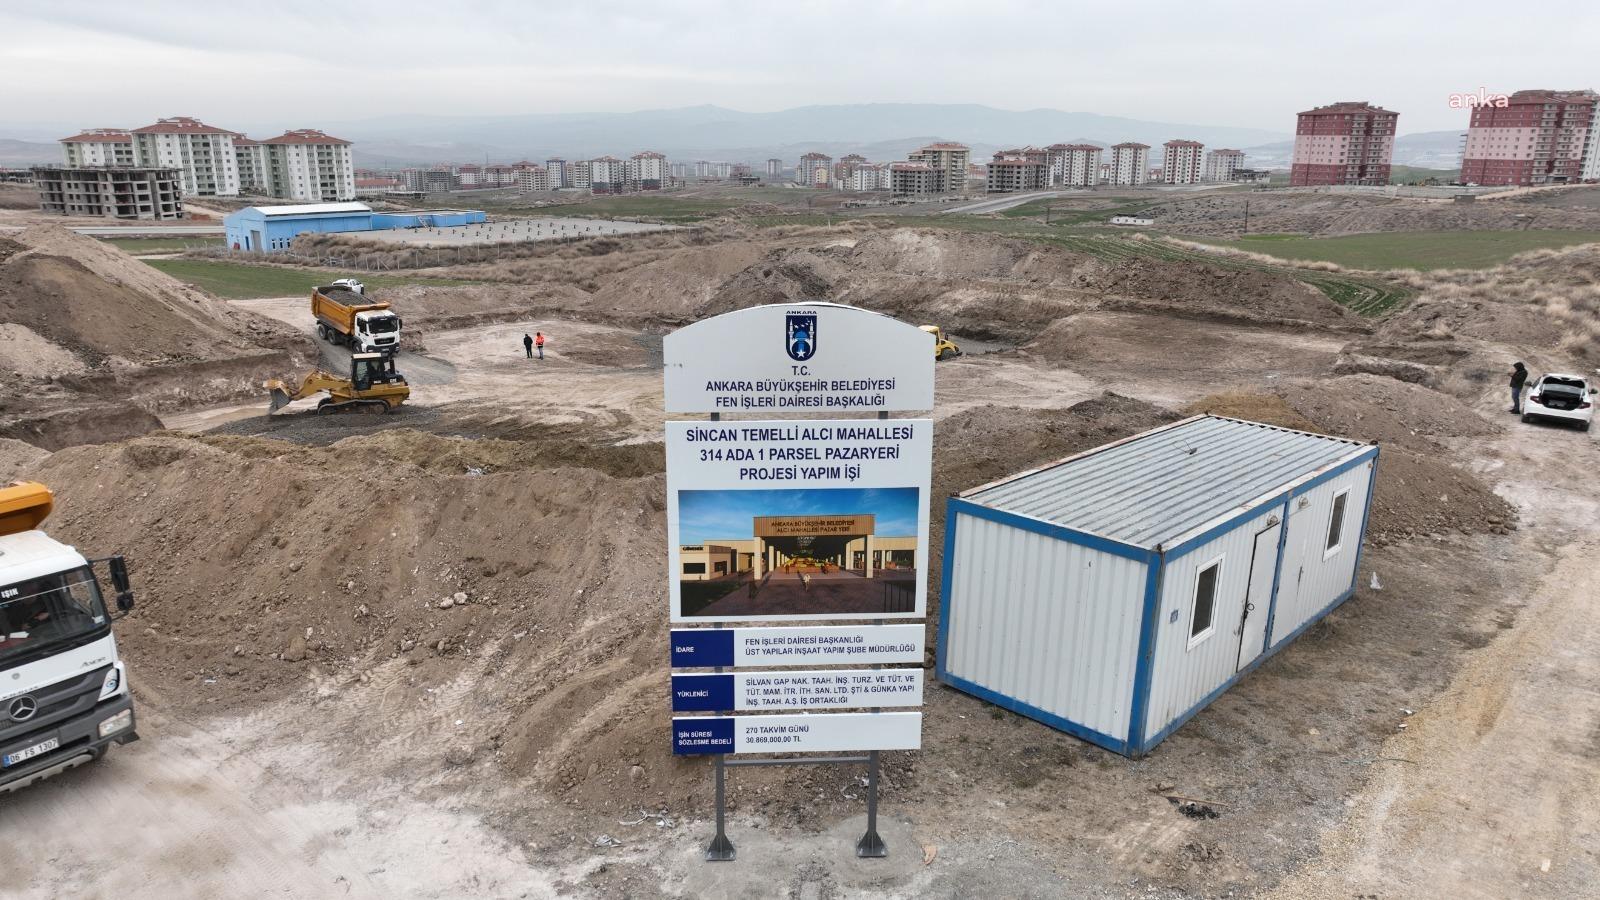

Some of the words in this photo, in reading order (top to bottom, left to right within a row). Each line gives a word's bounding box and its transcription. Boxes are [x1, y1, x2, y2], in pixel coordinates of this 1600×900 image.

[792, 366, 811, 376] T.C.
[706, 381, 753, 392] ANKARA
[756, 378, 829, 394] BÜYÜKŞEHİR
[831, 377, 896, 391] BELEDİYESİ
[716, 396, 738, 408] FEN
[741, 394, 776, 410] İŞLERİ
[779, 393, 823, 408] DAİRESİ
[826, 392, 885, 409] BAŞKALIĞI
[686, 426, 738, 442] SİNCAN
[741, 425, 799, 442] TEMELLİ
[802, 428, 833, 441] ALCI
[837, 424, 914, 441] MAHALLESİ
[700, 448, 723, 461] 314
[726, 448, 755, 461] ADA
[758, 448, 764, 461] 1
[769, 447, 821, 461] PARSEL
[825, 443, 900, 460] PAZARYERİ
[740, 464, 797, 480] PROJESİ
[800, 466, 841, 480] YAPIM
[844, 464, 861, 482] İŞİ
[745, 638, 760, 646] FEN
[761, 636, 786, 647] İŞLERİ
[787, 636, 817, 645] DAİRESİ
[818, 635, 864, 645] BAŞKANLIĞI
[675, 645, 695, 653] İDARE
[745, 647, 760, 656] ÜST
[762, 647, 793, 656] YAPILAR
[795, 646, 821, 656] İNŞAAT
[823, 646, 846, 655] YAPIM
[847, 646, 867, 655] ŞUBE
[868, 643, 916, 653] MÜDÜRLÜĞÜ
[746, 676, 771, 686] SİLVAN
[774, 678, 790, 686] GAP
[791, 677, 810, 685] NAK.
[812, 677, 833, 685] TAAH.
[875, 675, 886, 683] VE
[905, 675, 915, 683] VE
[677, 689, 709, 698] YÜKLENİCİ
[763, 687, 783, 696] MAM.
[814, 686, 832, 695] SAN.
[833, 686, 850, 695] LTD.
[864, 686, 870, 694] &
[871, 684, 898, 694] GÜNKA
[898, 685, 915, 693] YAPI
[762, 698, 783, 706] TAAH.
[809, 695, 848, 705] ORTAKLIĞI
[759, 725, 787, 734] TAKVİM
[788, 724, 809, 733] GÜNÜ
[792, 735, 802, 743] TL
